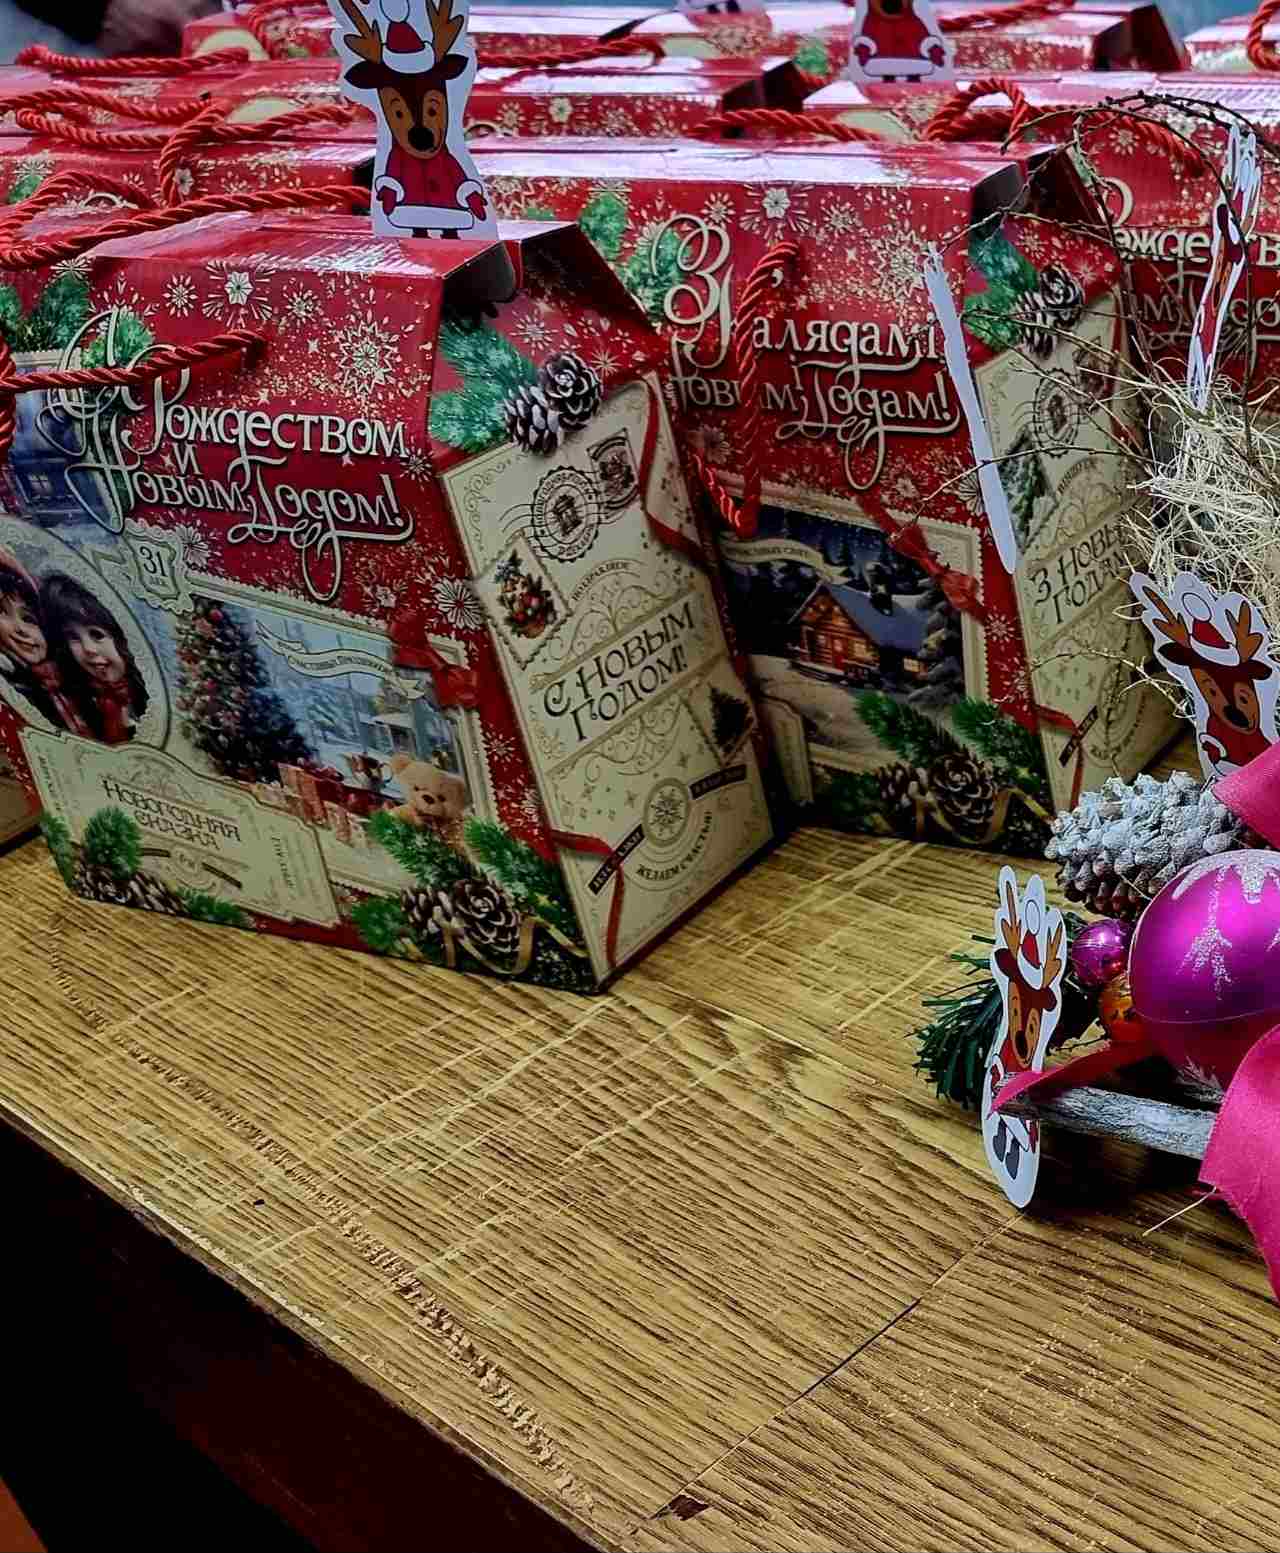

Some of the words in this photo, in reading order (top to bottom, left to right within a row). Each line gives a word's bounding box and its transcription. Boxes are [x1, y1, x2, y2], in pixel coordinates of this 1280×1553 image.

[139, 545, 168, 577] 31
[226, 464, 413, 601] Годом!
[1057, 520, 1127, 586] НОВЫ
[543, 679, 571, 717] С
[576, 602, 695, 699] НОВЫМ
[570, 645, 688, 741] ГОДОМ!
